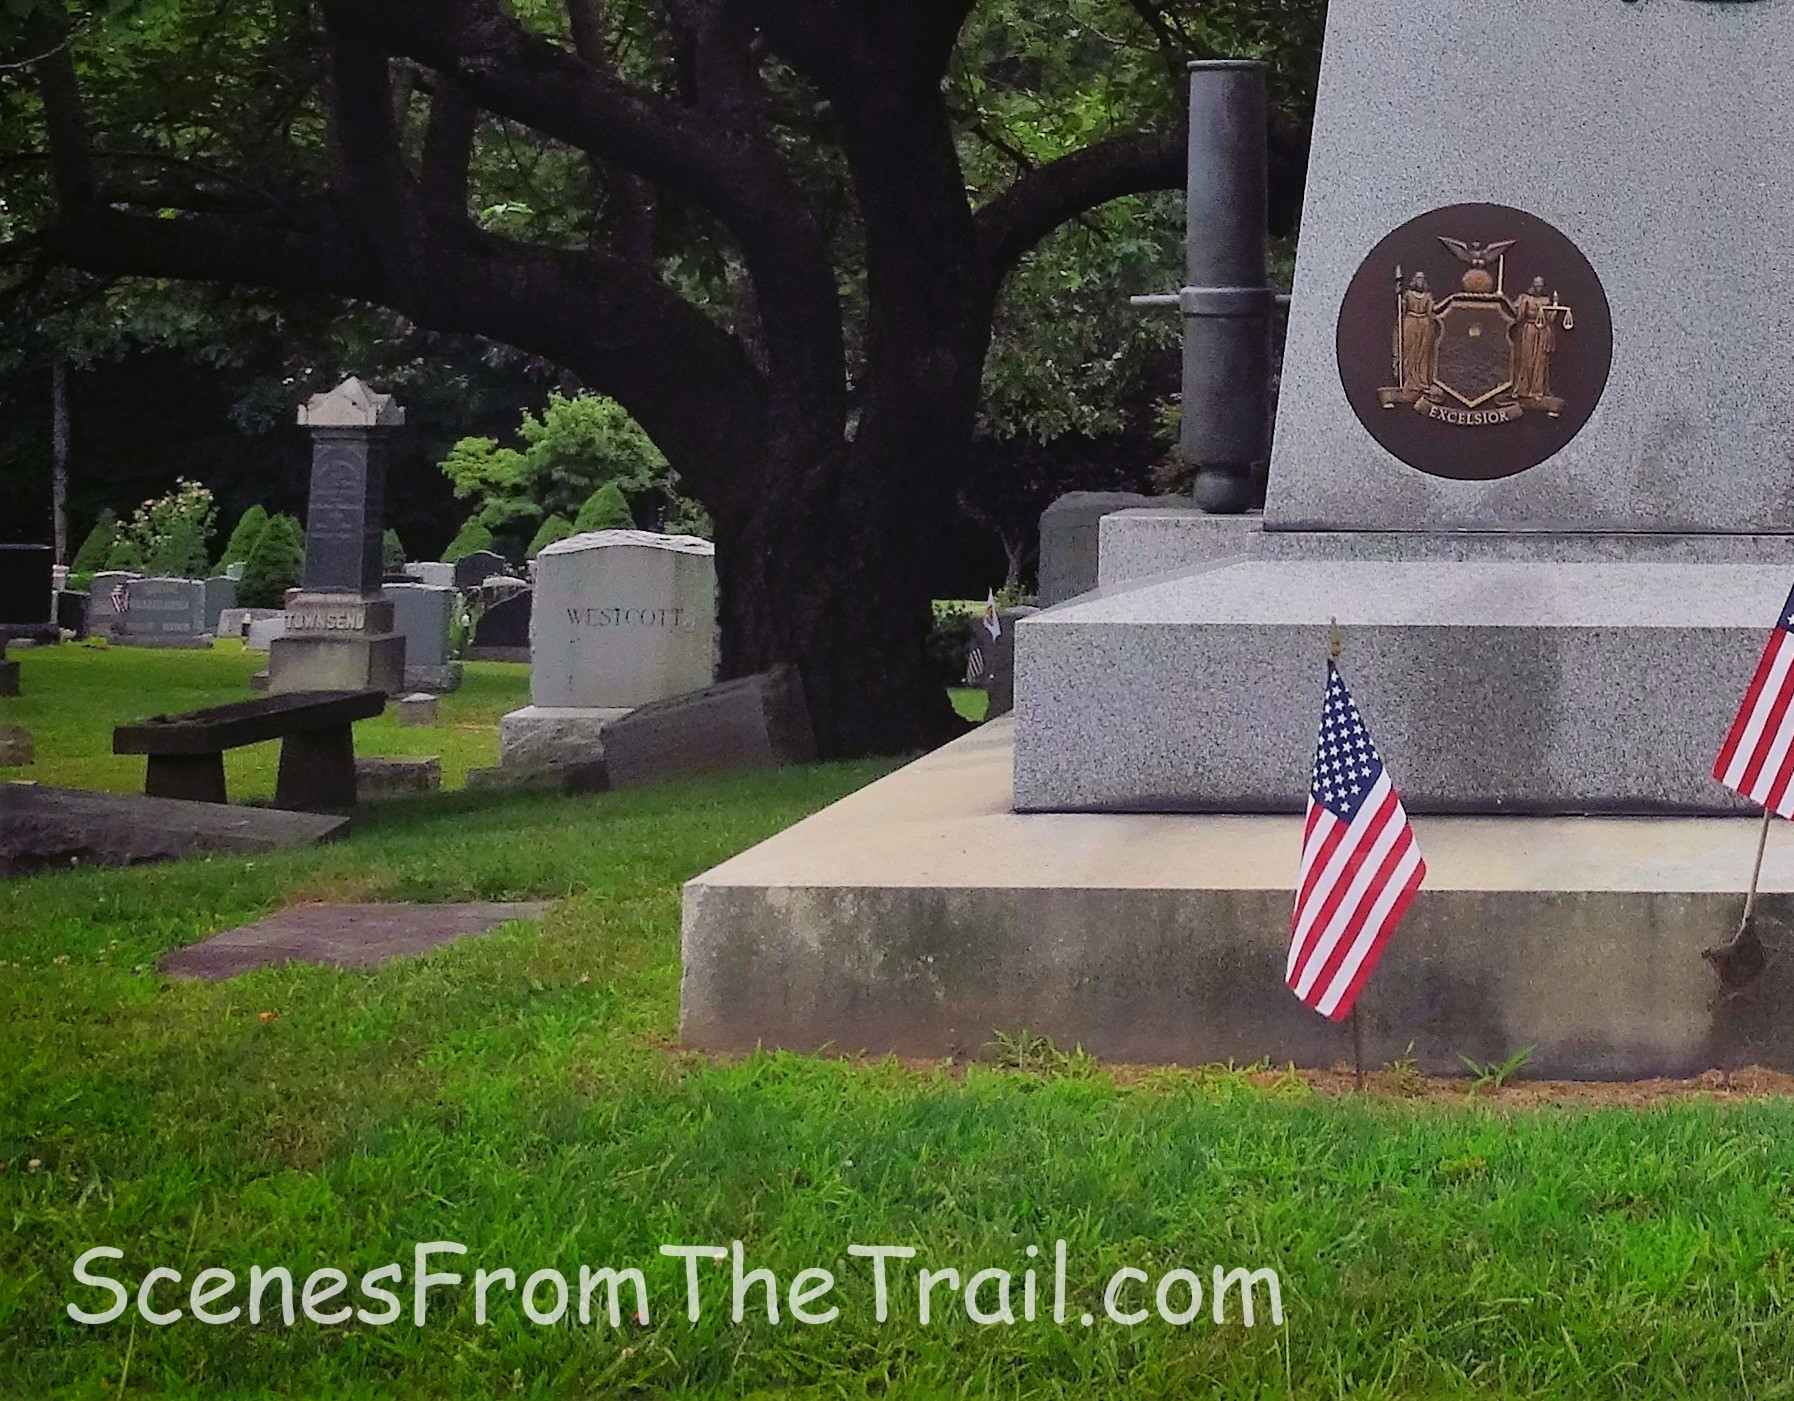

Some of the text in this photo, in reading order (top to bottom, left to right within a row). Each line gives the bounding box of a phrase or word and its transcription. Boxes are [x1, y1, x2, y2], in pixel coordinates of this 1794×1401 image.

[1428, 405, 1509, 425] EXCELSIOR
[285, 612, 365, 631] TOWNSEND
[567, 607, 684, 627] WESTCOTT
